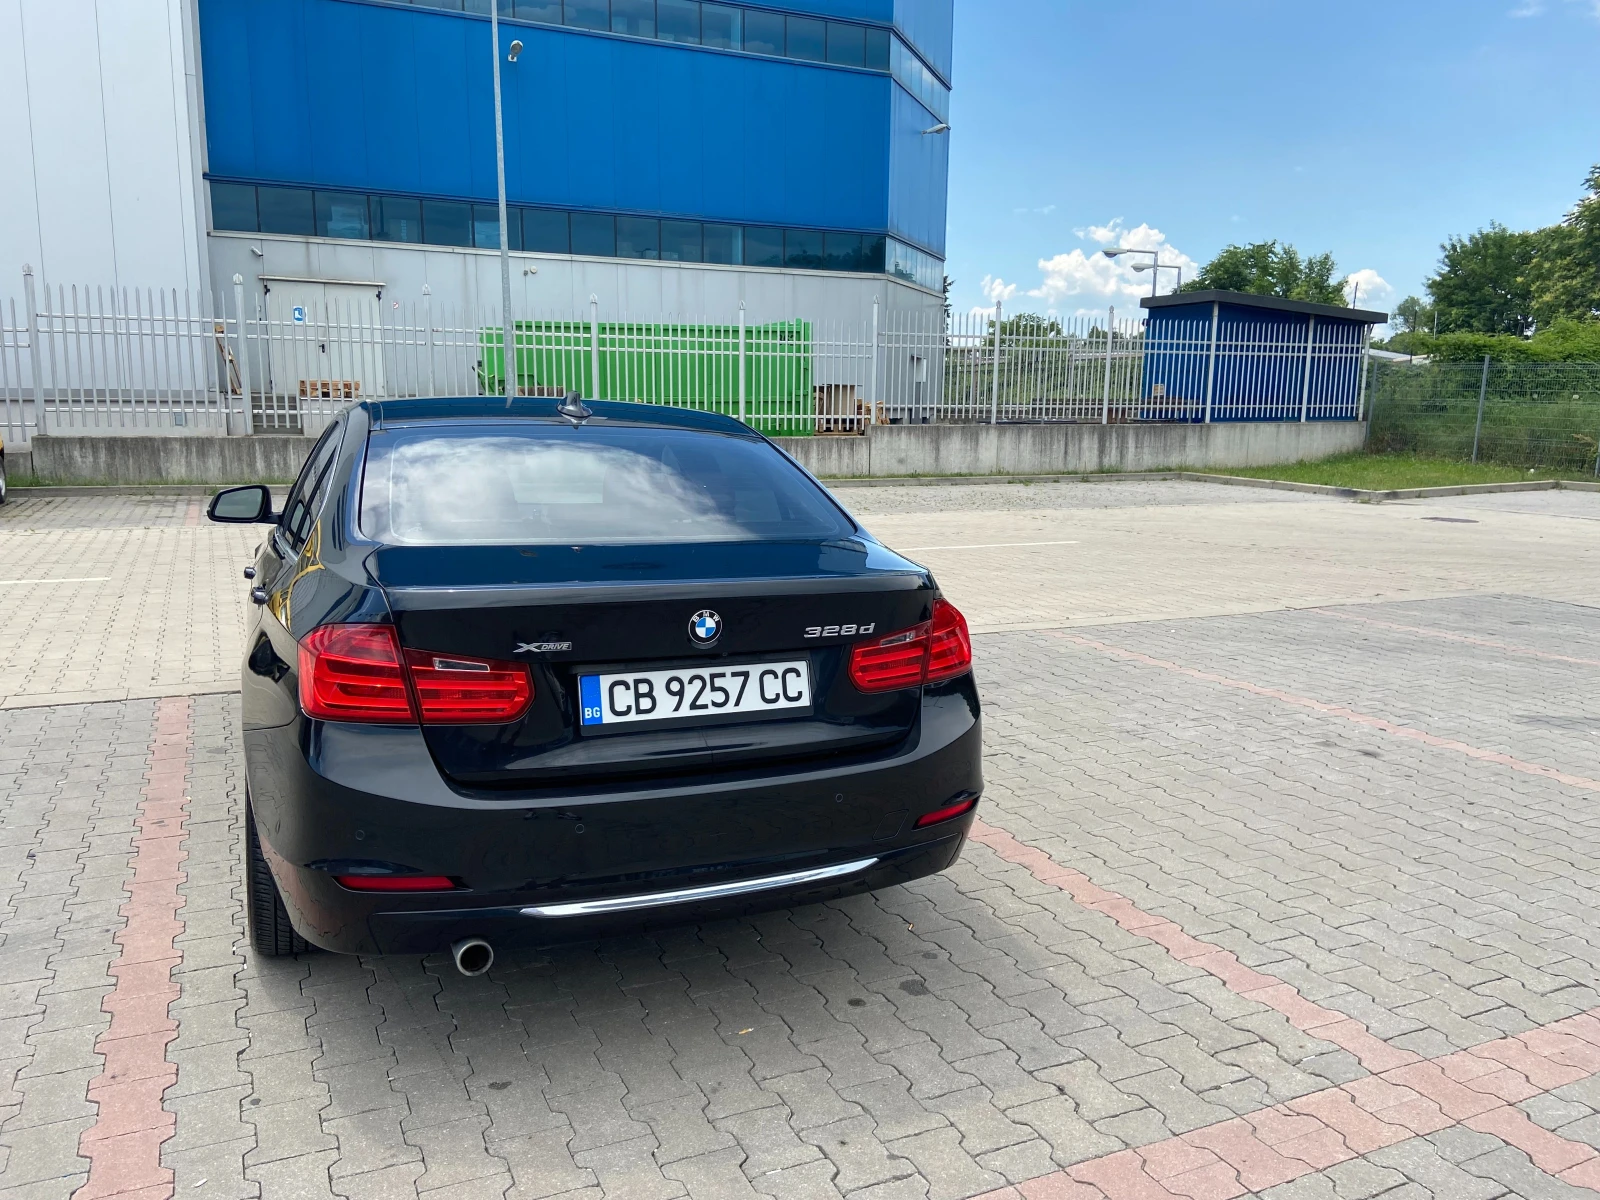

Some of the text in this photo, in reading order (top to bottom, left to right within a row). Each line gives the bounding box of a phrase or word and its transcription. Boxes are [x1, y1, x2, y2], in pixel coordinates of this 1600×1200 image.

[692, 611, 720, 622] BMW
[608, 667, 803, 717] CB 9257 CC
[584, 706, 601, 719] BG
